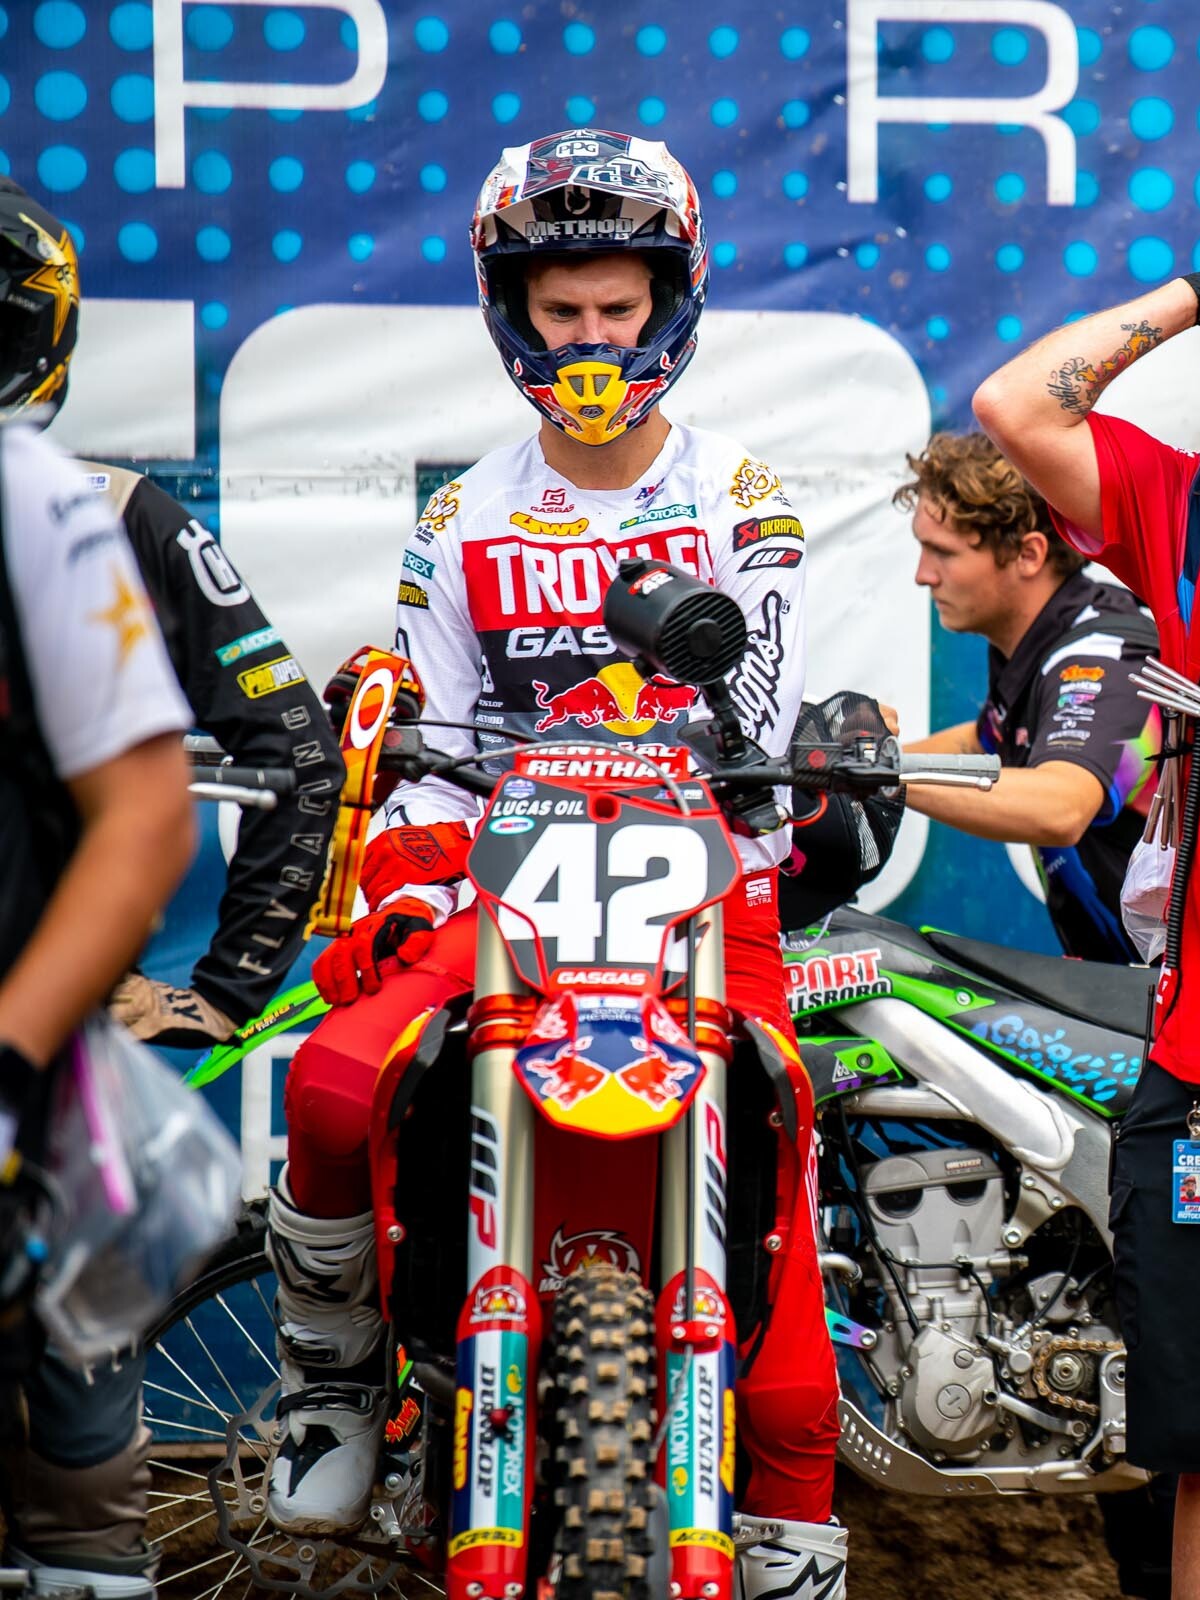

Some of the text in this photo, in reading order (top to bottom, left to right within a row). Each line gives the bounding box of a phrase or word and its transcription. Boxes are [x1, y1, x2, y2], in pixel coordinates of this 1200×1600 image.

[557, 142, 597, 154] PPG
[526, 218, 633, 237] METHOD
[530, 503, 575, 513] GASGAS
[638, 505, 694, 524] MOTOREX
[642, 572, 674, 595] 42
[526, 759, 678, 778] RENTHAL
[491, 800, 584, 817] LUCAS OIL
[498, 822, 709, 963] 42
[746, 877, 771, 899] SE
[747, 897, 772, 907] ULTRA
[557, 971, 646, 986] GASGAS
[699, 1364, 716, 1501] DUNLOP
